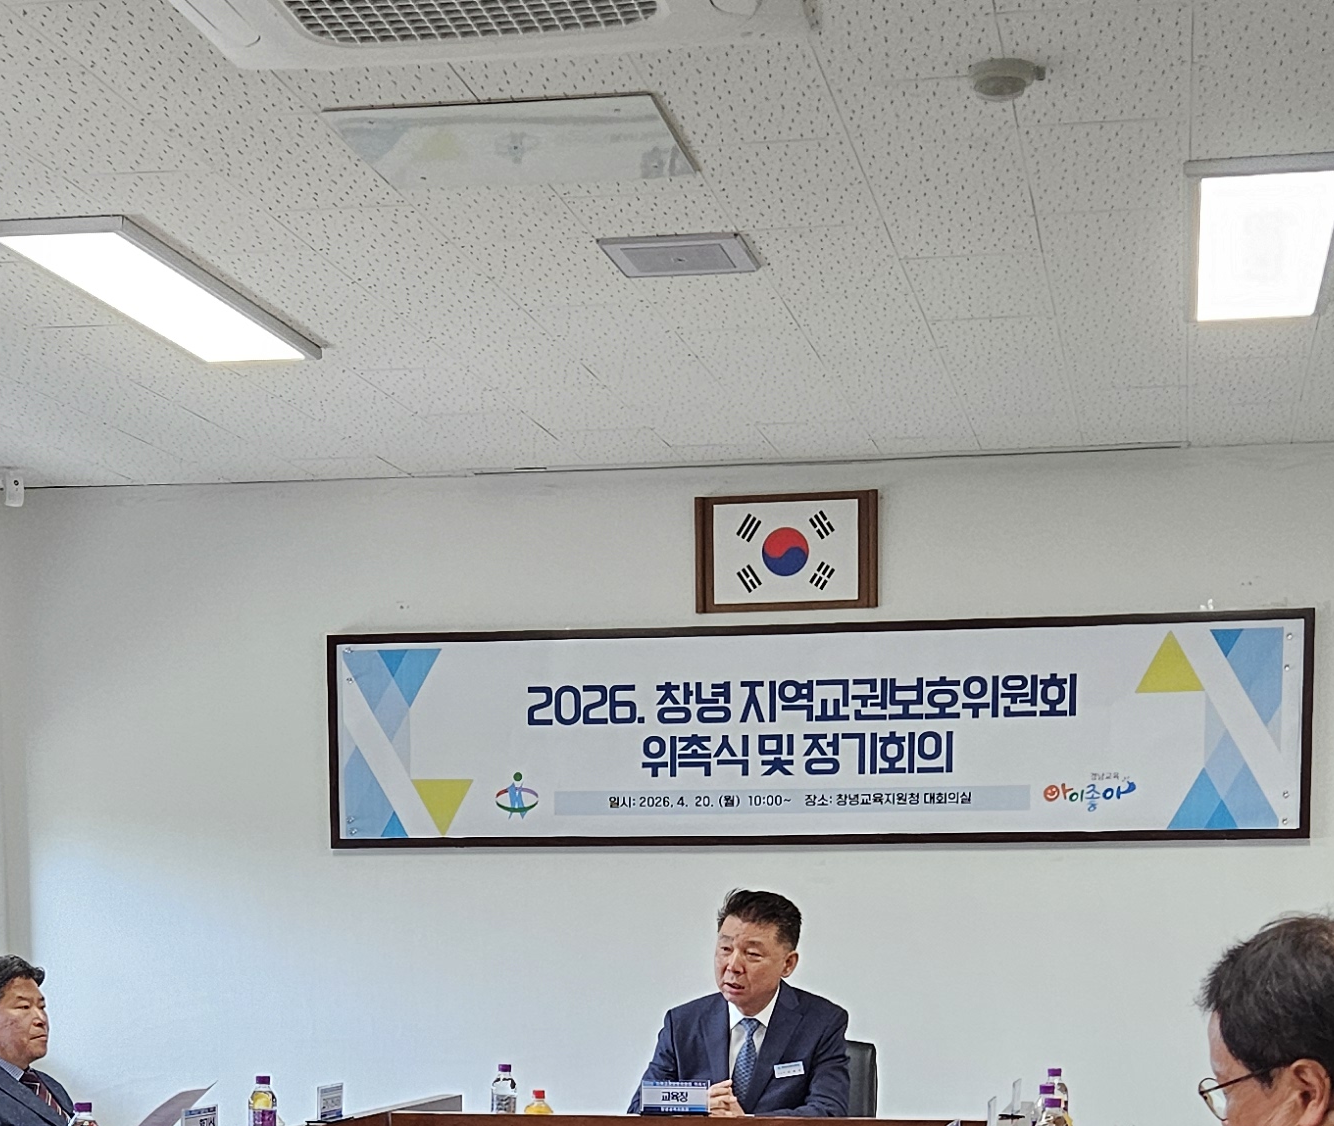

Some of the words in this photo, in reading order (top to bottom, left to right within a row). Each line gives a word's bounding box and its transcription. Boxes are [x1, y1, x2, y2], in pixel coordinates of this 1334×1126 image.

[527, 684, 645, 726] 2026.
[655, 680, 732, 725] 창녕
[739, 673, 1078, 724] 지역교권보호위원회
[641, 733, 749, 778] 위촉식
[757, 733, 795, 777] 및
[803, 730, 954, 776] 정기회의
[608, 796, 636, 809] 일시:
[676, 796, 688, 807] 4.
[695, 795, 714, 807] 20.
[718, 795, 740, 808] (월)
[748, 795, 791, 807] 10:00~
[804, 794, 832, 807] 장소:
[836, 793, 920, 806] 창녕교육지원청
[923, 792, 972, 805] 대회의실
[1043, 781, 1137, 812] 아이좋아
